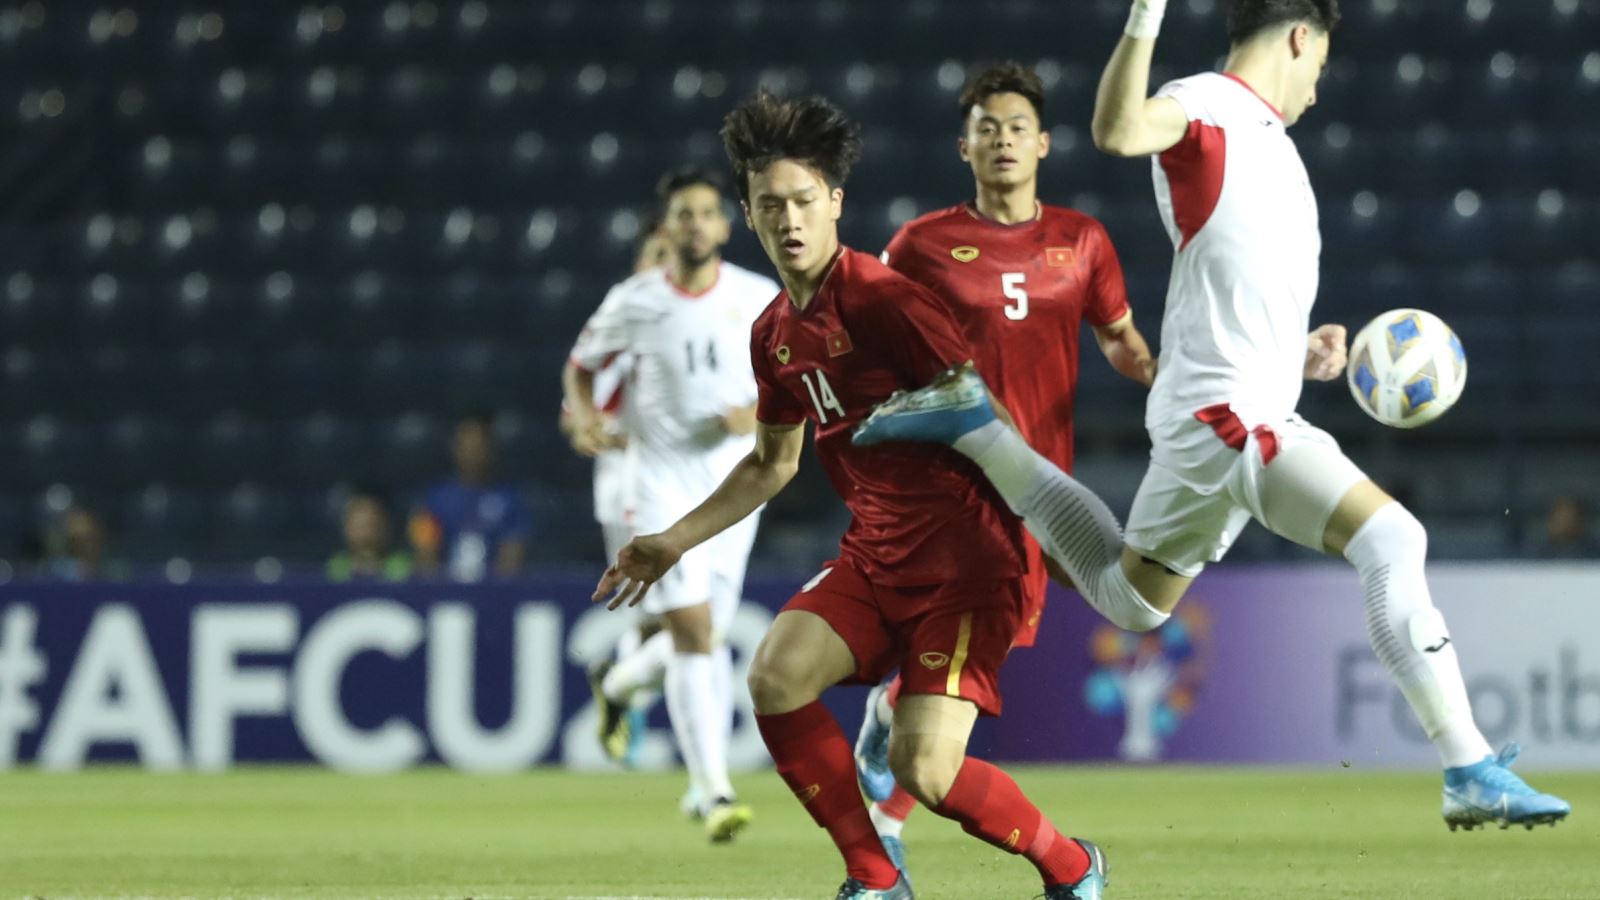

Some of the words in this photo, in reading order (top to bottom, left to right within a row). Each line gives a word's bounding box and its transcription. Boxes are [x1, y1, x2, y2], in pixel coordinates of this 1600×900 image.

[1001, 272, 1029, 321] 5
[684, 338, 719, 375] 14
[801, 368, 846, 424] 14
